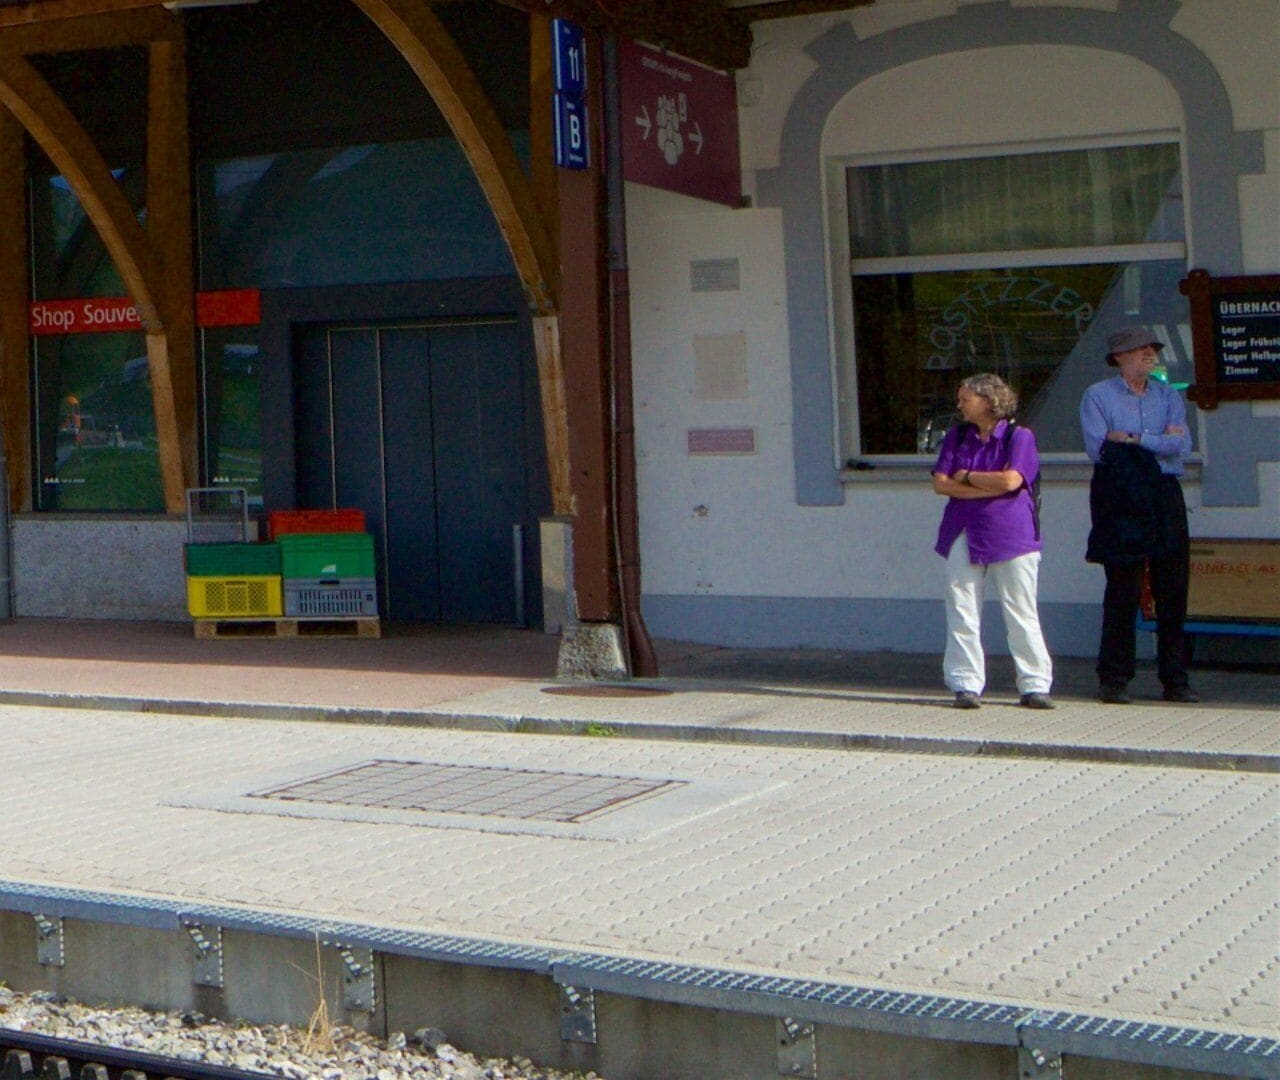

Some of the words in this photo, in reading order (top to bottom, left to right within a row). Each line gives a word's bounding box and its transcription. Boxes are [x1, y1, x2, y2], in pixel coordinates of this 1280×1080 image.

[569, 46, 579, 82] 11
[570, 114, 581, 149] B
[32, 307, 74, 330] Shop
[1225, 366, 1259, 375] Zimmer
